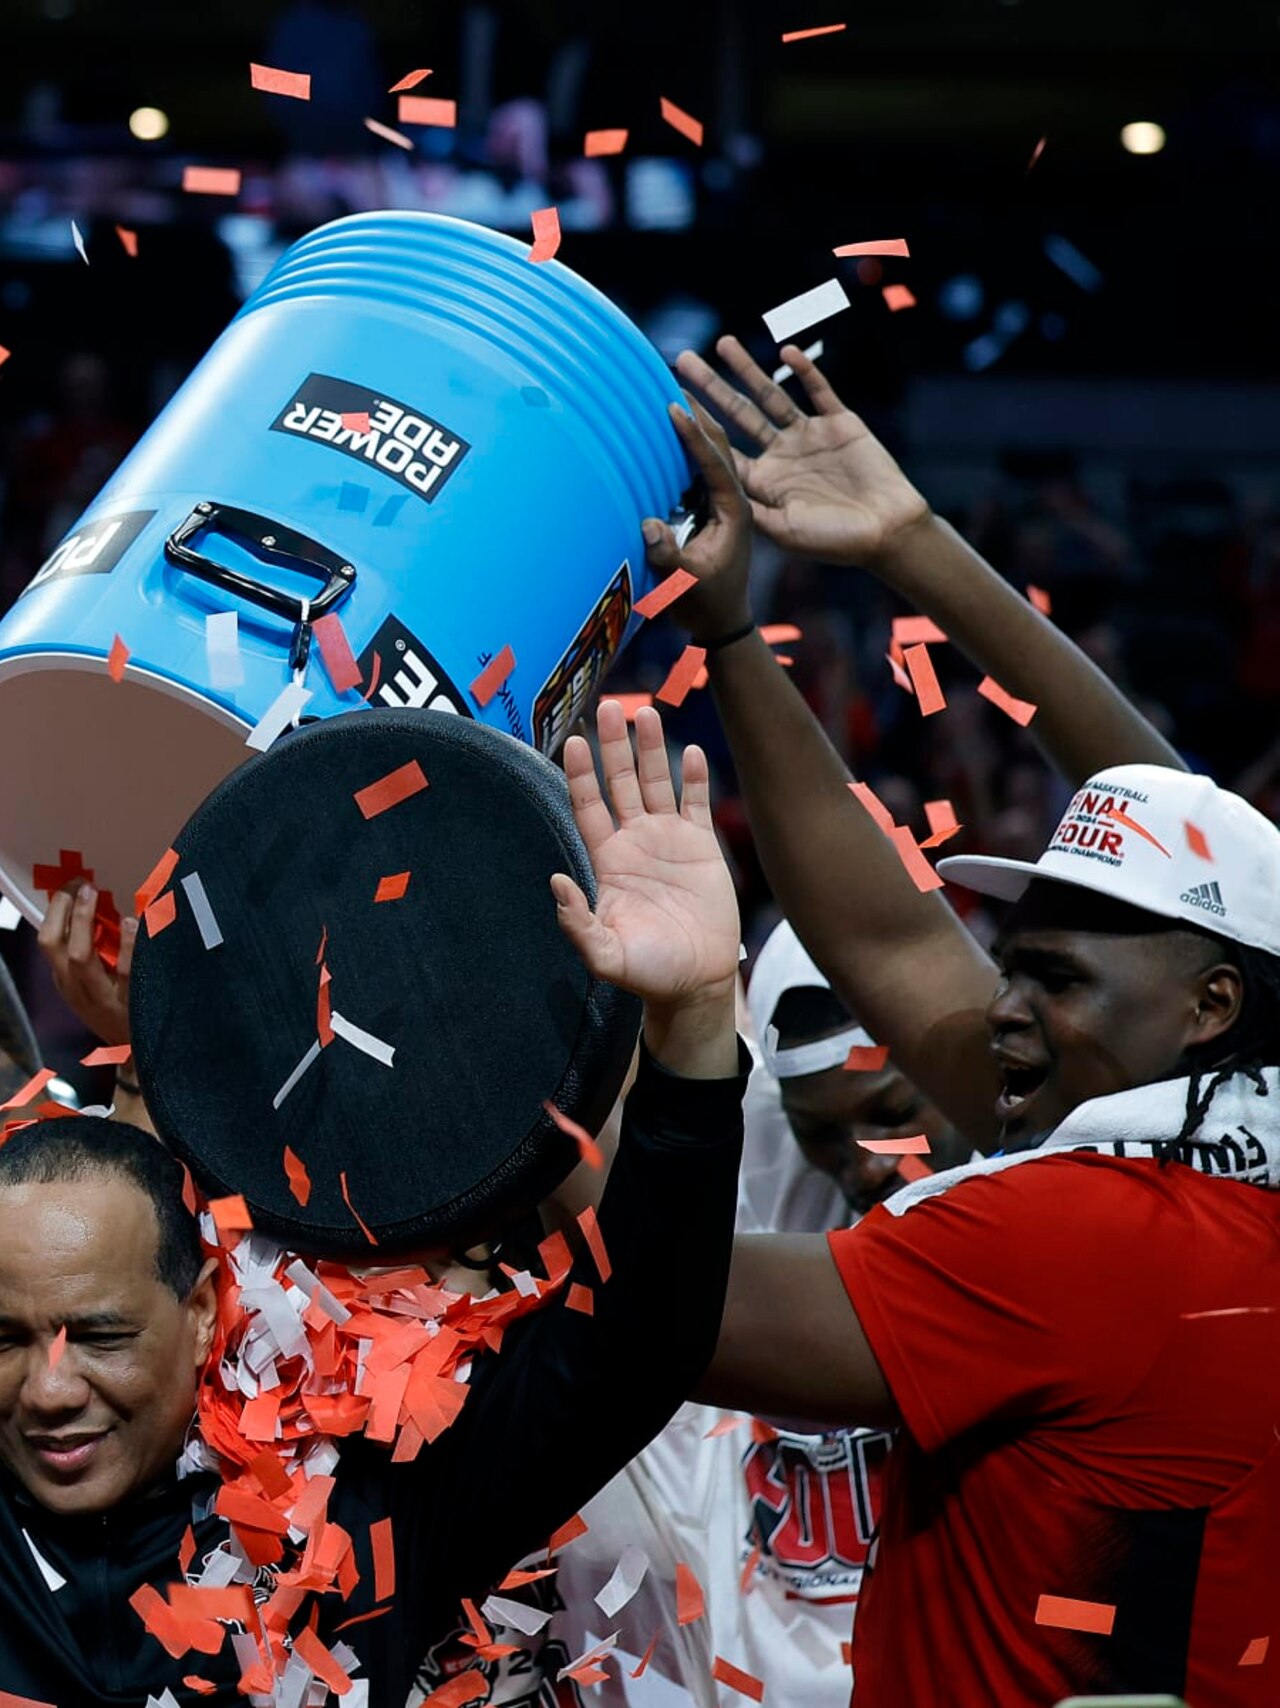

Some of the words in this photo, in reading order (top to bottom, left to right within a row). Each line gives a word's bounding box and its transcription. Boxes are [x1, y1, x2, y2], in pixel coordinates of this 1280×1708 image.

[283, 402, 443, 493] POWER
[497, 680, 525, 741] RINK
[1053, 822, 1124, 857] FOUR
[1179, 892, 1227, 918] adidas
